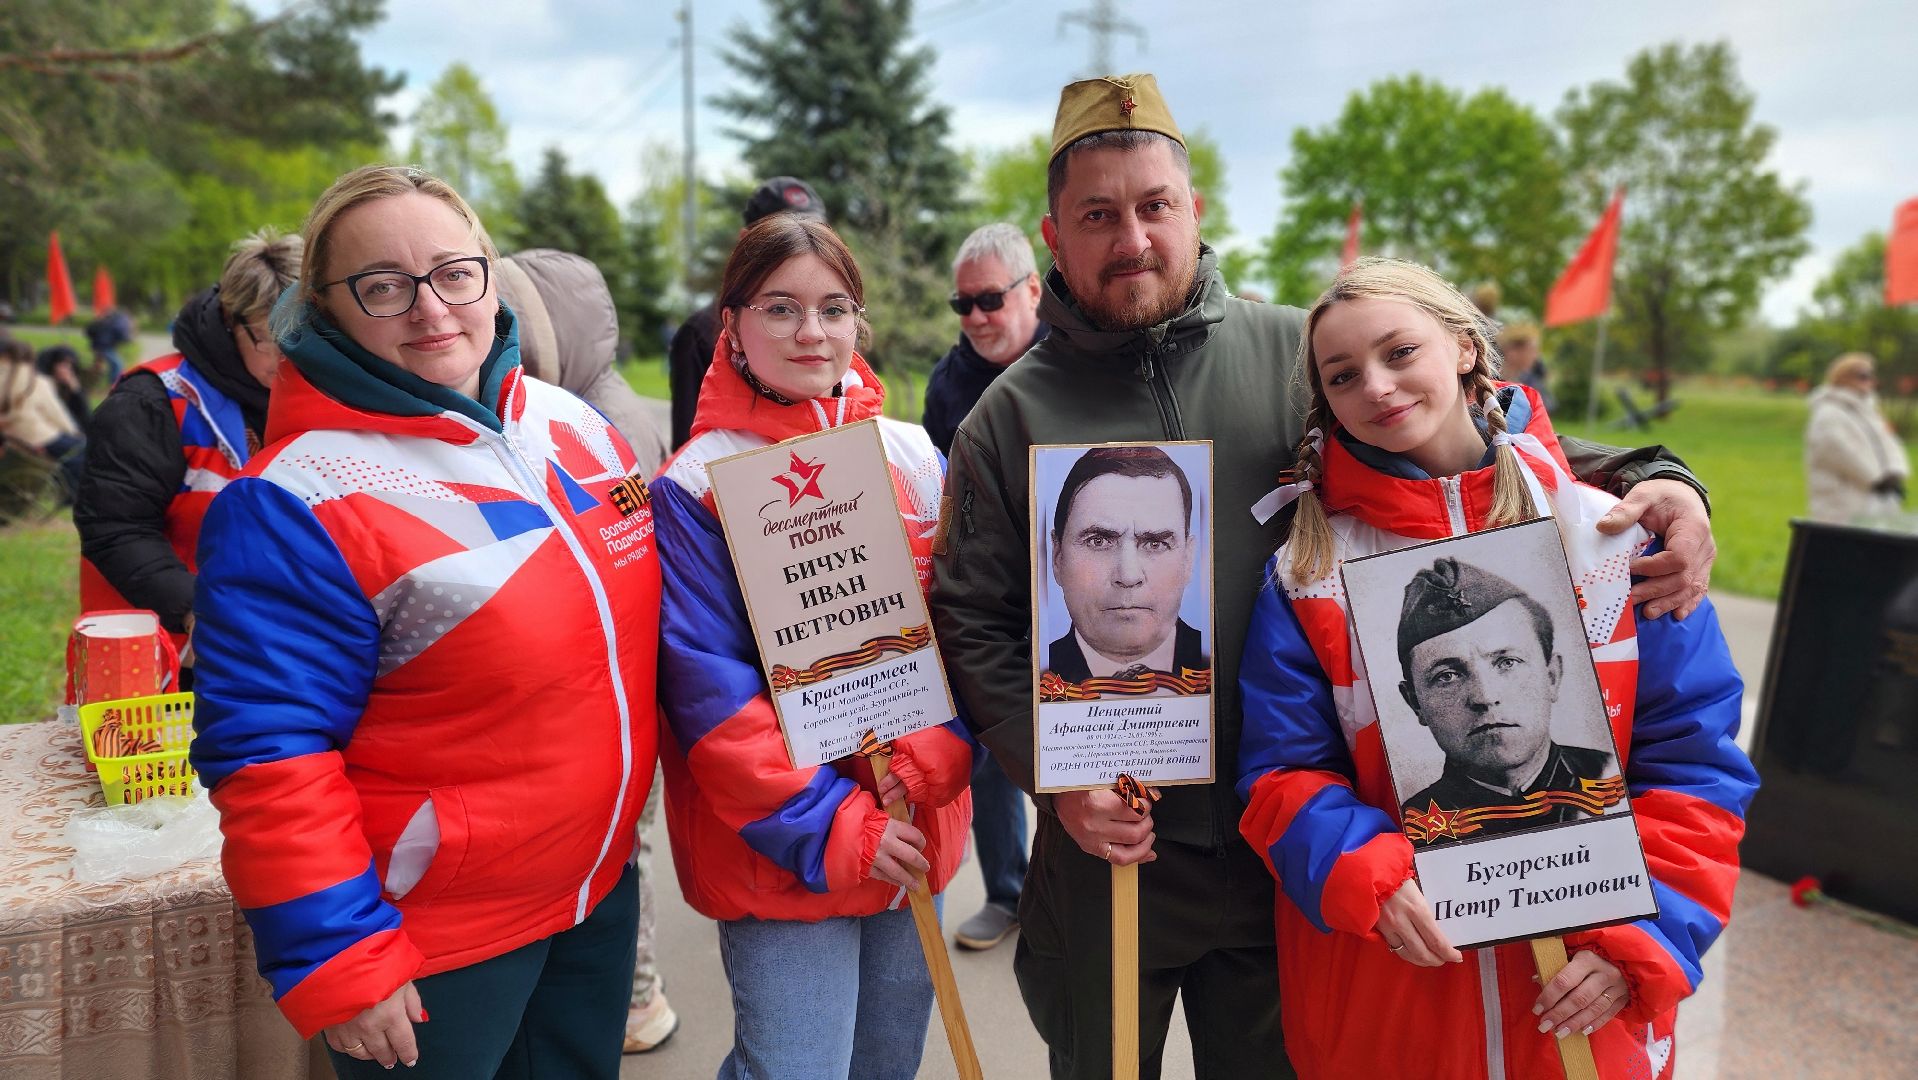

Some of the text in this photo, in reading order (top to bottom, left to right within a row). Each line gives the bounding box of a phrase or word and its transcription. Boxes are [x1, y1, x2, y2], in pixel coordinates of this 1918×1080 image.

[759, 490, 864, 537] бессмертный
[789, 520, 845, 550] ПОЛК
[614, 545, 648, 570] МЫ РЯДОМ
[782, 544, 869, 585] БИЧУК
[799, 574, 867, 609] ИВАН
[774, 592, 906, 647] ПЕТРОВИЧ
[800, 660, 919, 707] Красноармеец
[839, 686, 887, 706] Молдавская
[819, 735, 848, 750] Место
[1049, 718, 1200, 737] Афанасий Дмитриевич
[1050, 754, 1201, 771] ОРДЕН ОТЕЧЕСТВЕННОЙ ВОЙНЫ
[1108, 769, 1152, 779] СТПЕНИ
[1466, 844, 1592, 885] Бугорский
[1435, 873, 1641, 921] Петр Тихонович
